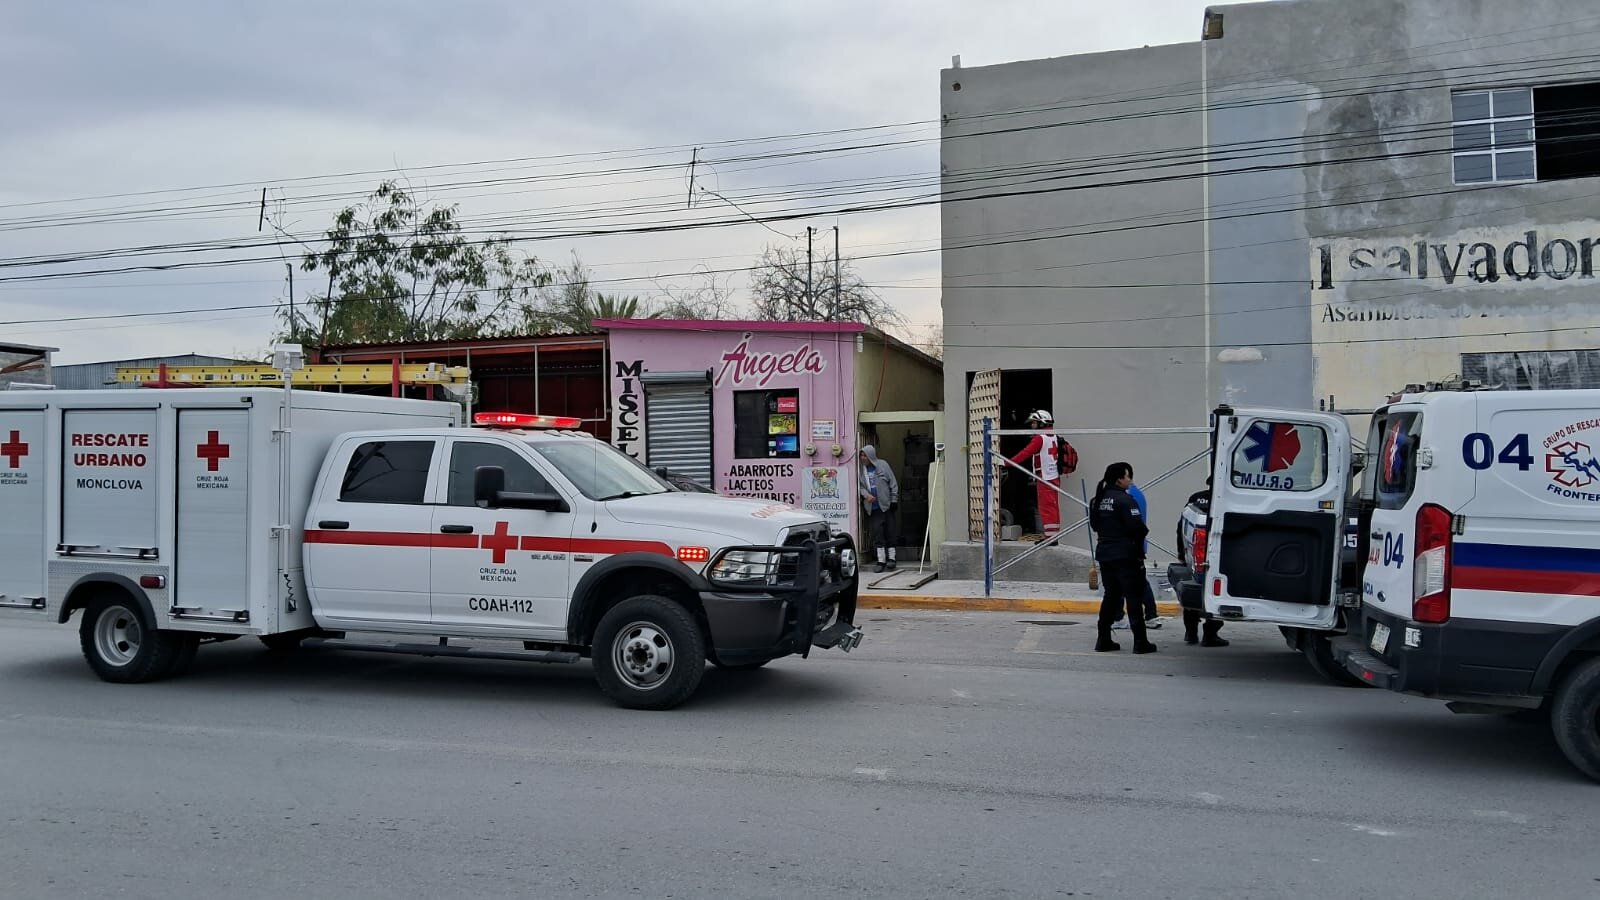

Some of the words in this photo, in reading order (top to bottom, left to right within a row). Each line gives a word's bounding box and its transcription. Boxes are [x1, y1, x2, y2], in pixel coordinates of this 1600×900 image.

[714, 332, 824, 387] Ángela
[71, 433, 149, 447] RESCATE
[1543, 429, 1566, 449] GRUPO
[1566, 424, 1577, 435] DE
[1576, 418, 1600, 431] RESCA
[1462, 432, 1535, 472] 04
[74, 453, 147, 467] URBANO
[730, 464, 794, 477] ABARROTES
[76, 478, 143, 490] MONCLOVA
[728, 479, 774, 491] LACTEOS
[1384, 531, 1404, 569] 04
[479, 567, 497, 575] CRUZ
[480, 575, 517, 583] MEXICANA
[468, 597, 534, 614] COAH-112
